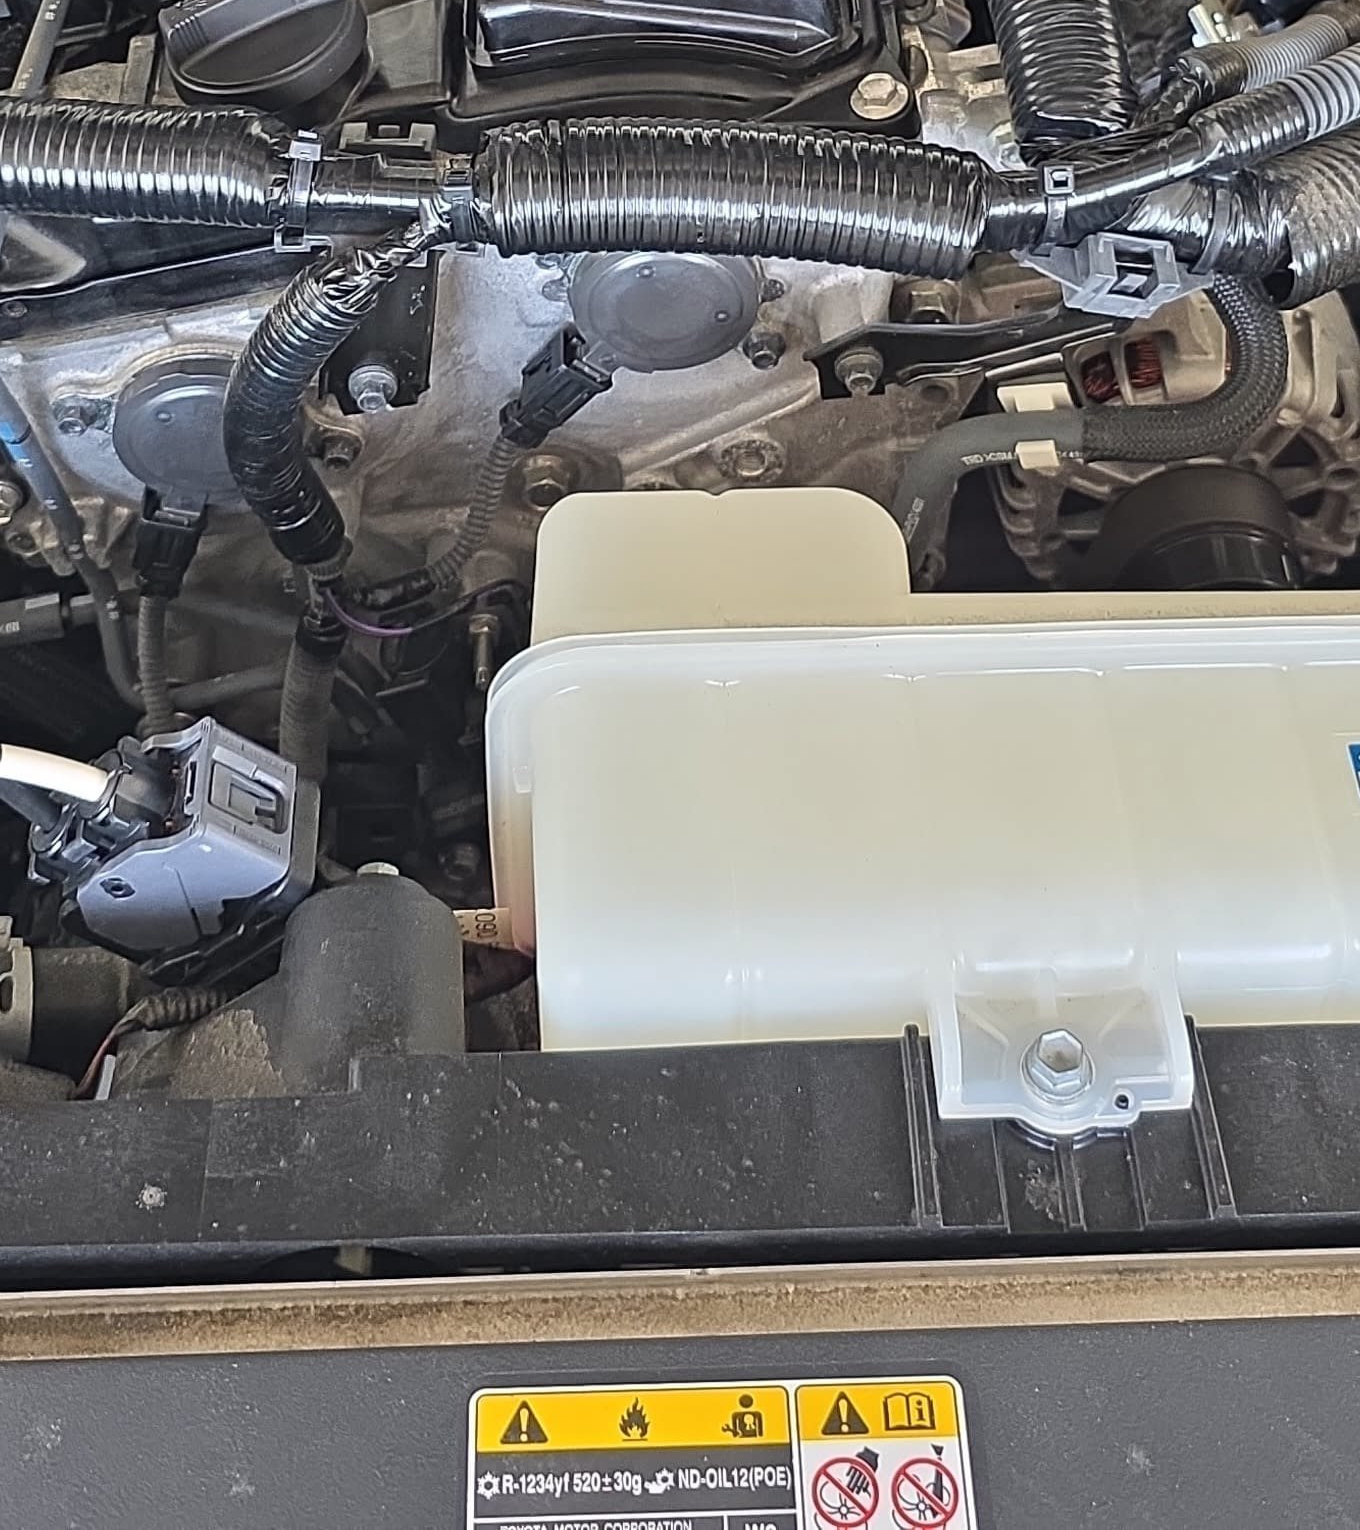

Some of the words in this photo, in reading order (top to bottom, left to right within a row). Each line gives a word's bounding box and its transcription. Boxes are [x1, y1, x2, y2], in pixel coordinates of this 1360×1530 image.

[501, 1472, 570, 1498] R-1234yf
[572, 1470, 642, 1496] 520±30g
[677, 1465, 793, 1491] ND-OIL12(POE)
